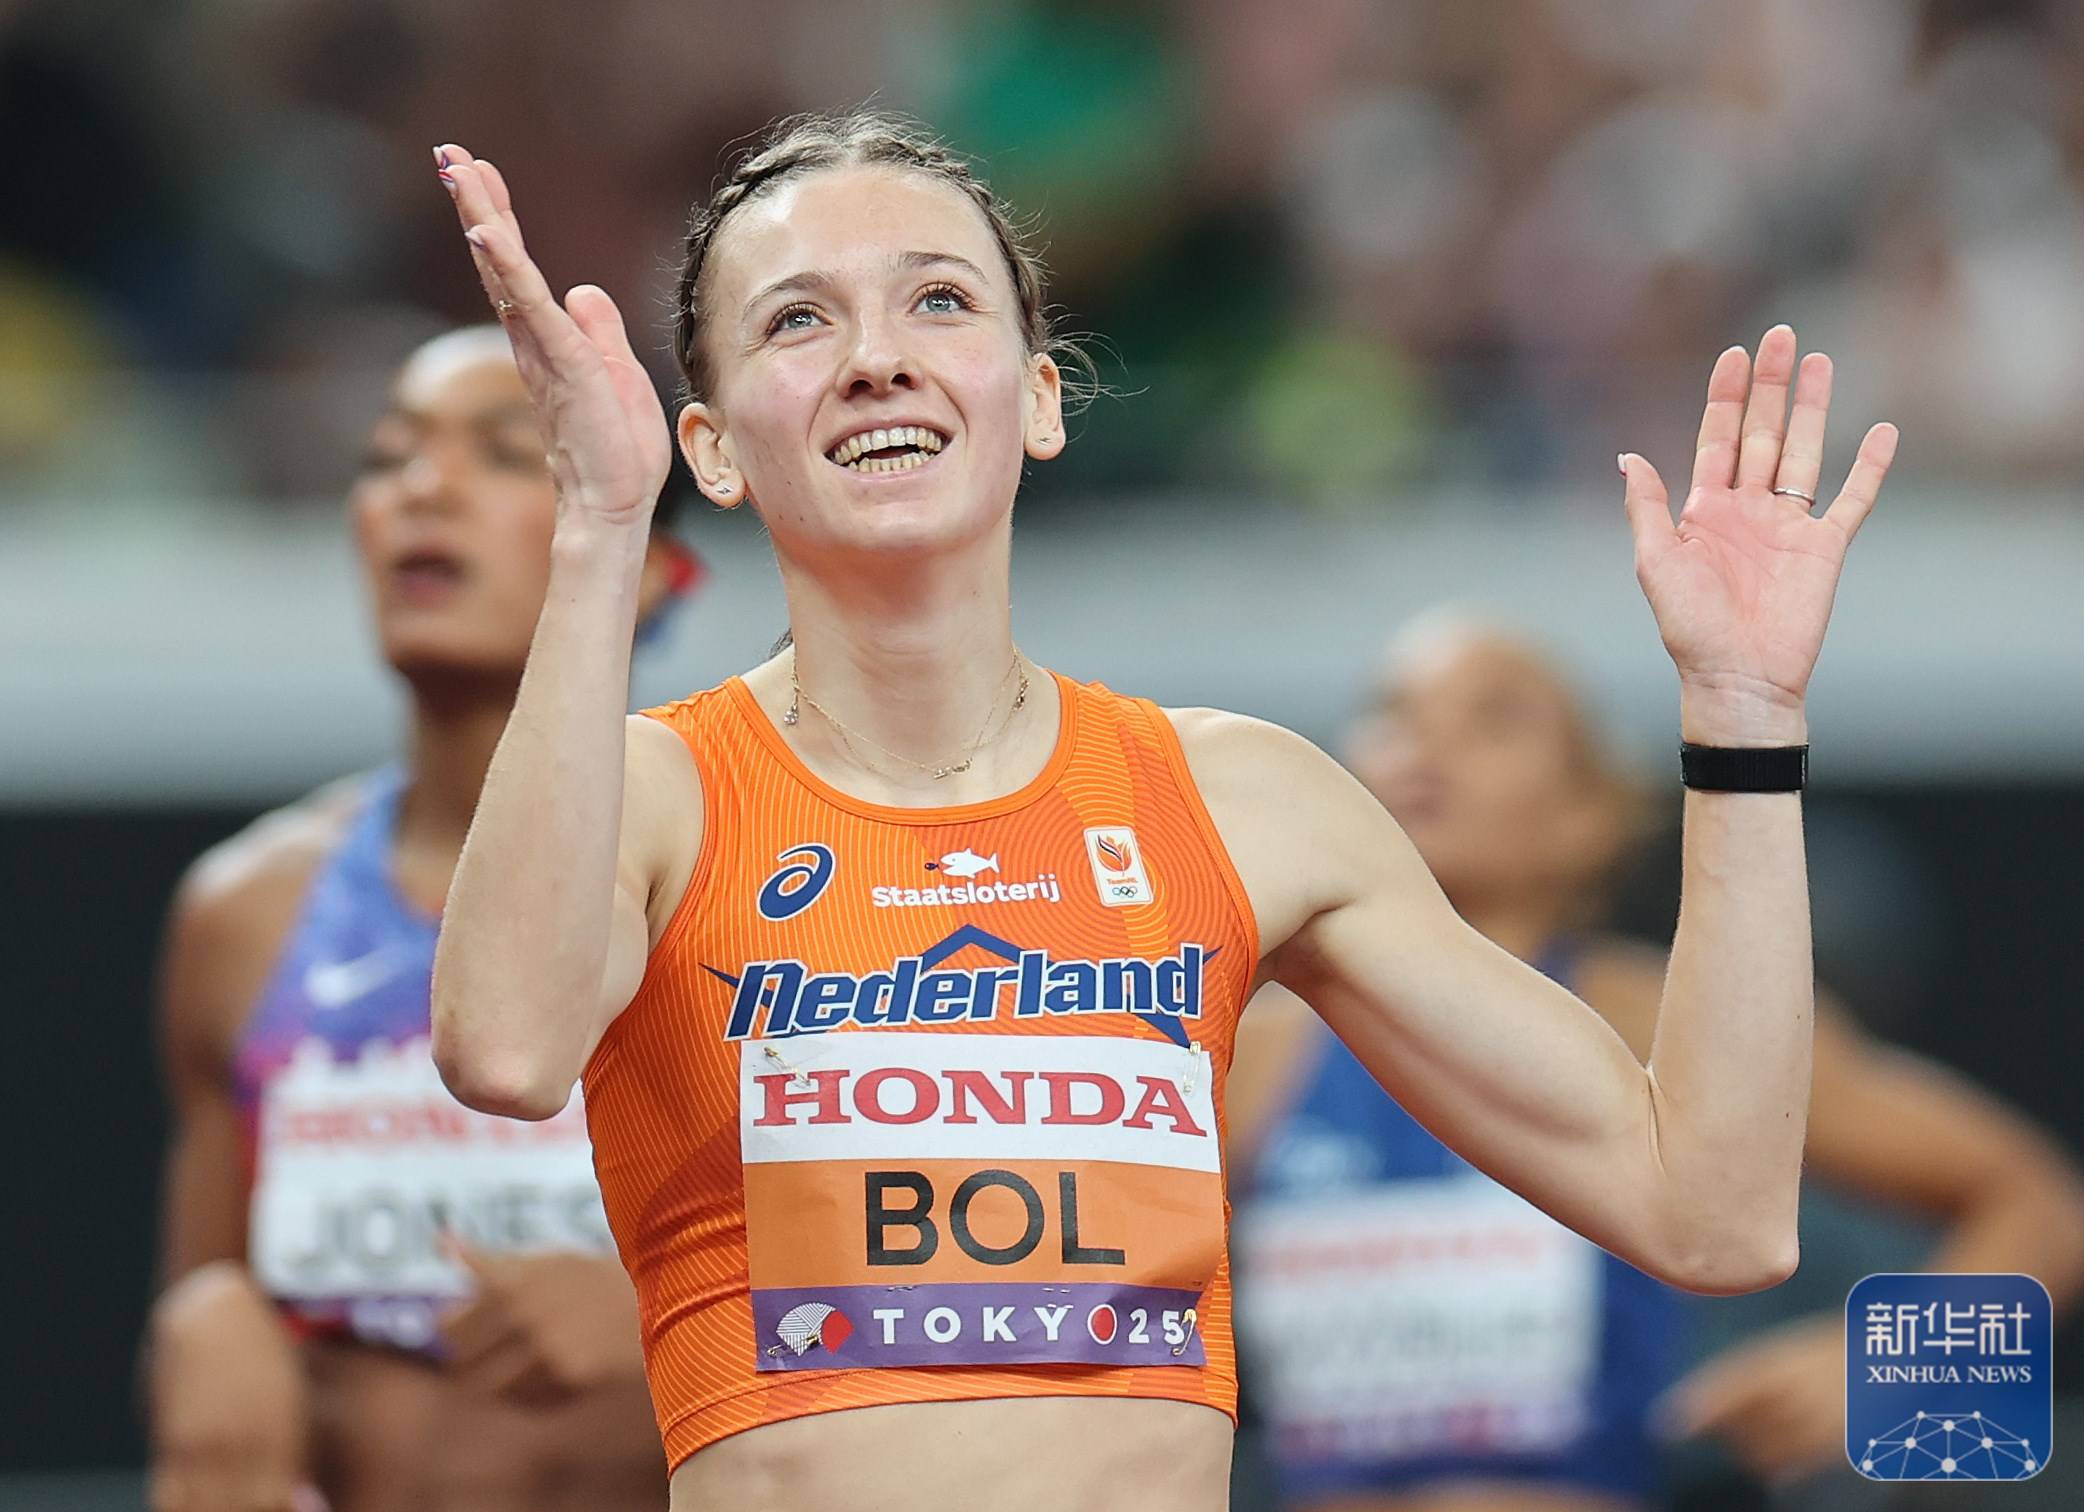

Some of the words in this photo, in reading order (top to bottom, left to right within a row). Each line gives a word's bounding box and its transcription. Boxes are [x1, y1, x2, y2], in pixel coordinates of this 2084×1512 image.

[872, 875, 1060, 908] Staatsloterij
[723, 942, 1204, 1041] Nederland
[752, 1067, 1208, 1137] HONDA
[864, 1169, 1126, 1267] BOL
